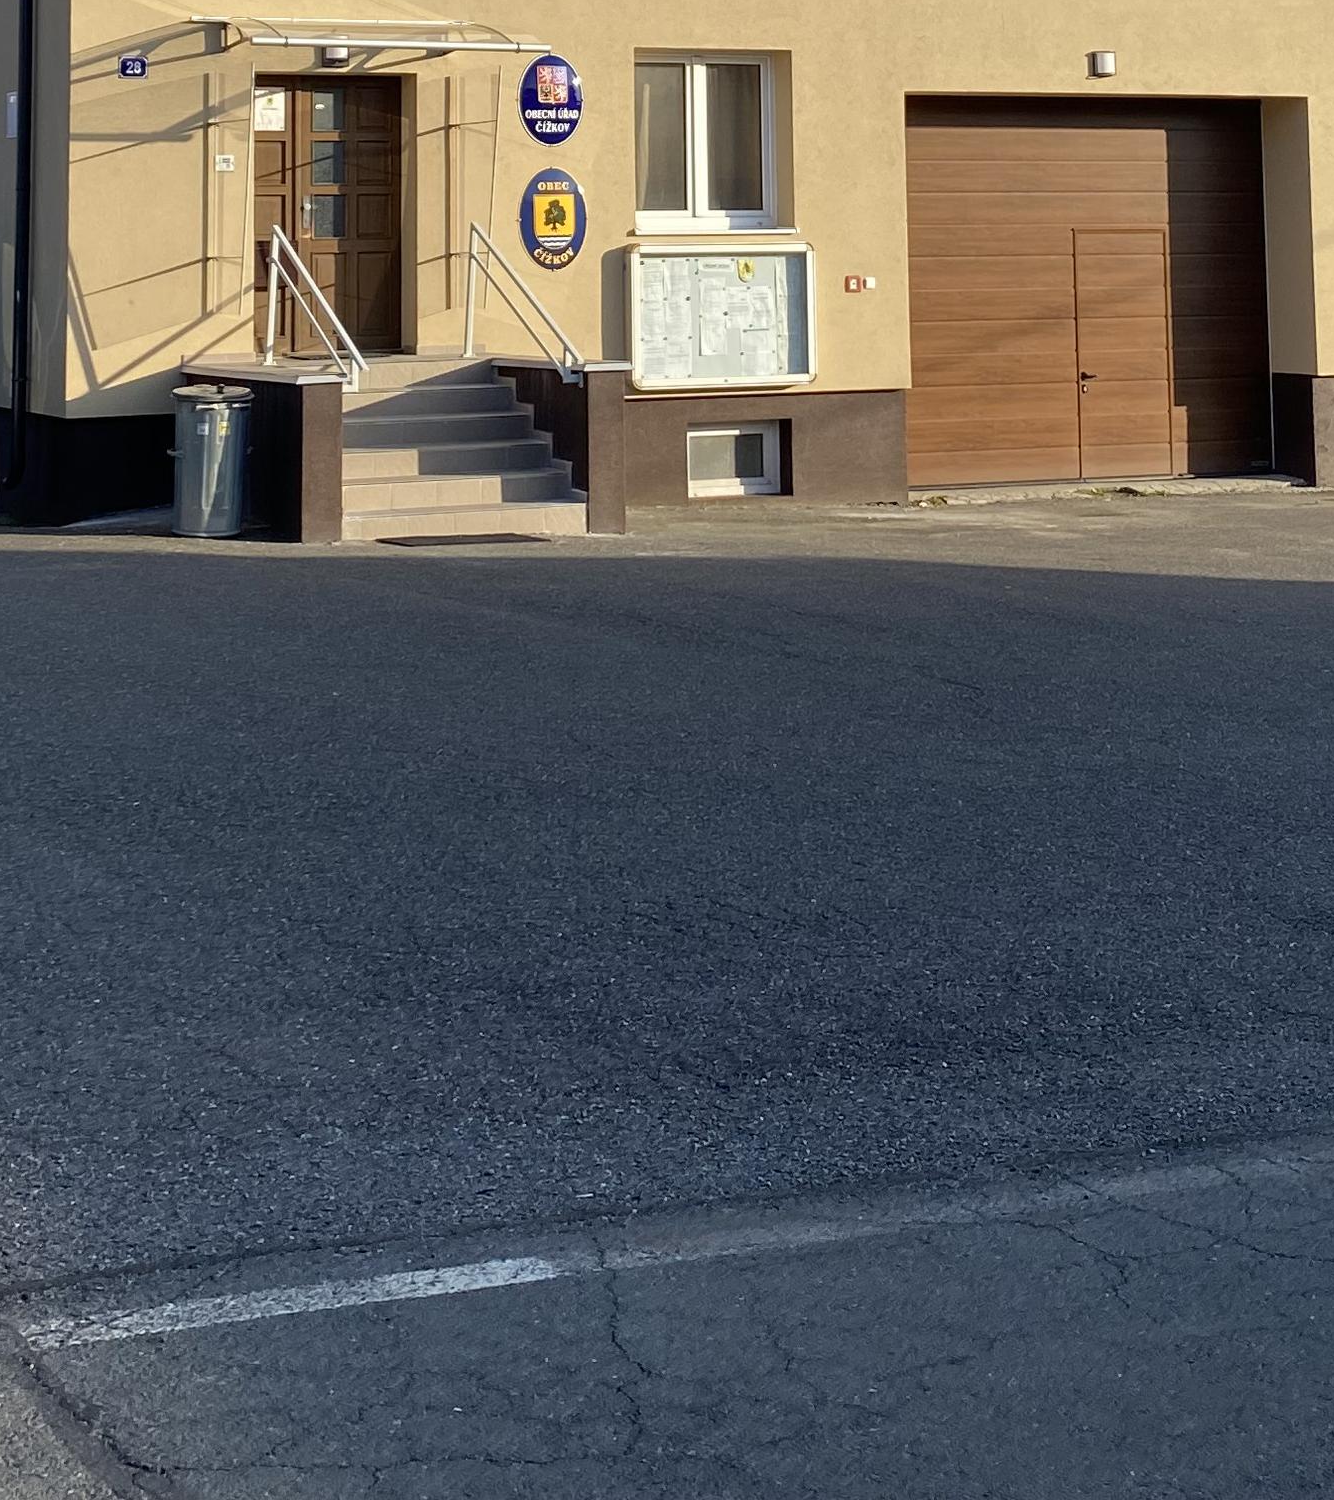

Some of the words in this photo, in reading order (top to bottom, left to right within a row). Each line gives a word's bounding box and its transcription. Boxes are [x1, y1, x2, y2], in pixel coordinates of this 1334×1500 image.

[126, 61, 142, 74] 28
[525, 107, 557, 119] OBECNÍ
[557, 107, 580, 119] ÚŘAD
[535, 120, 570, 133] ČÍŽKOV
[537, 181, 569, 191] OBEC
[533, 246, 574, 265] ČÍŽKOV
